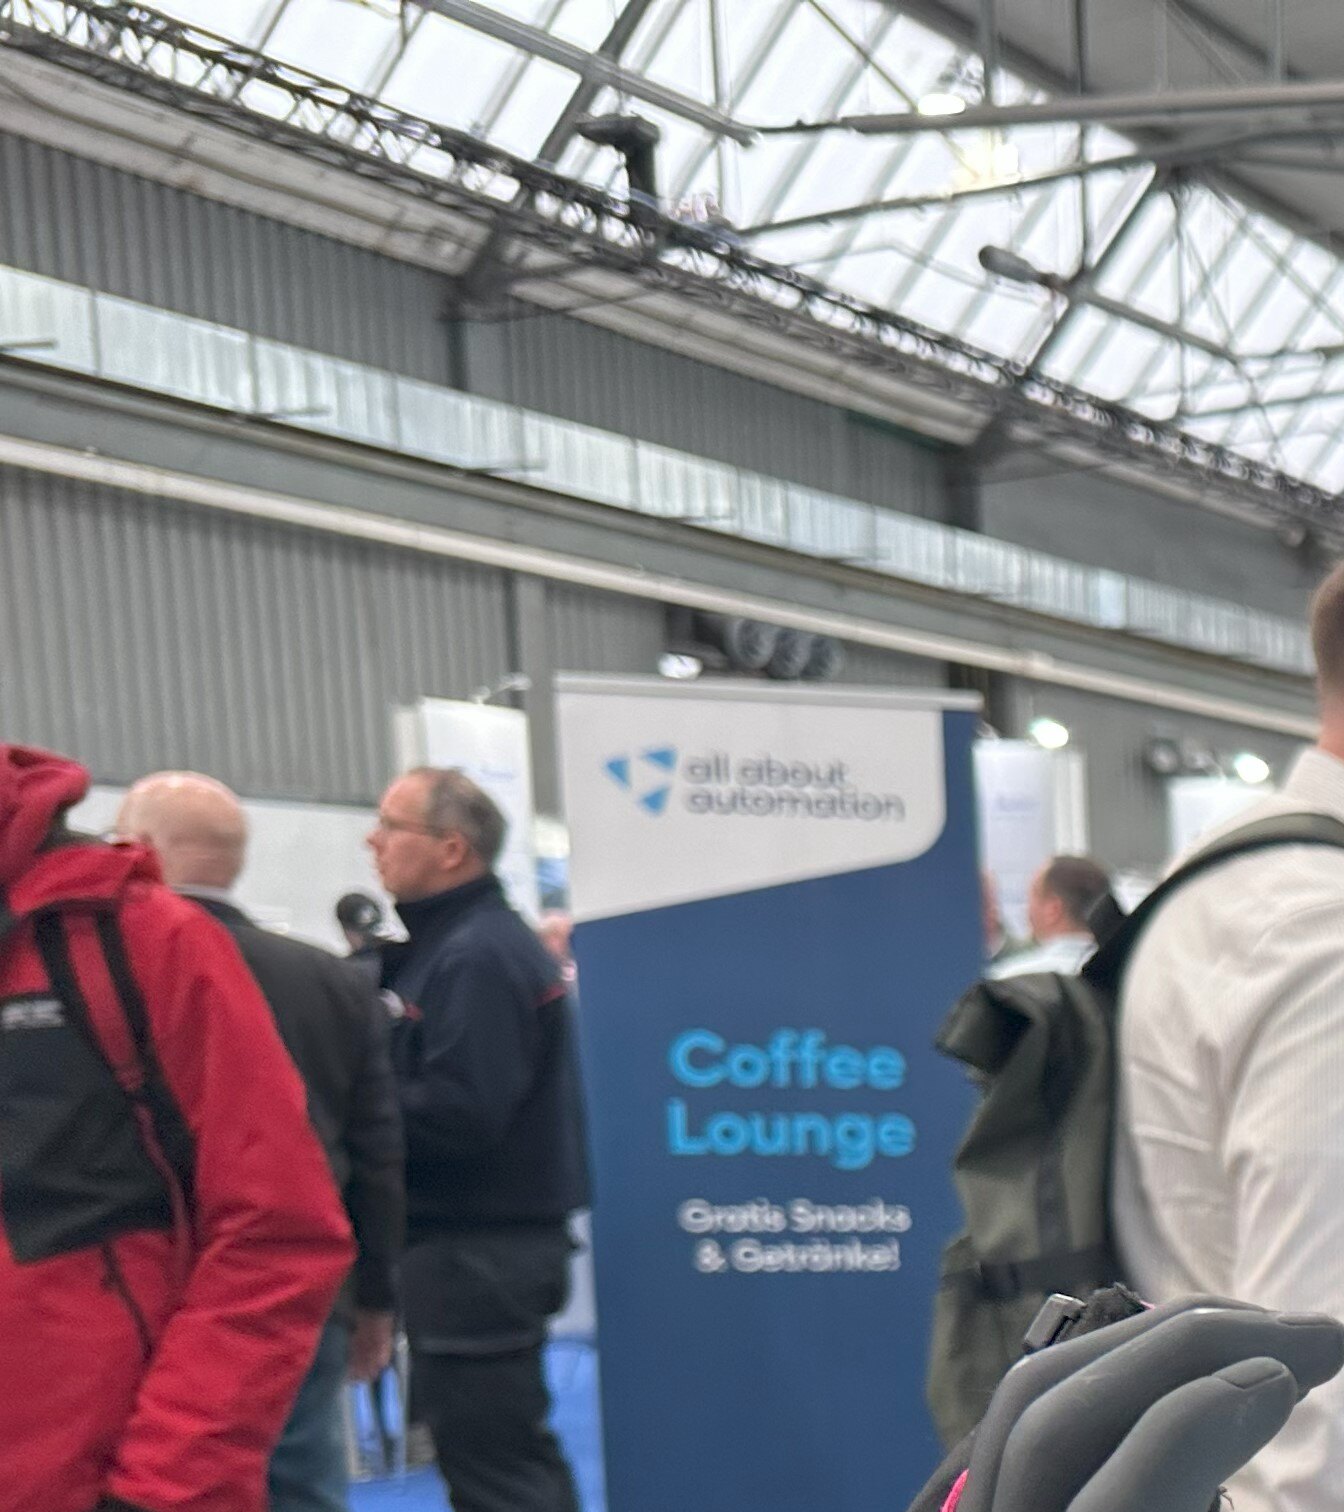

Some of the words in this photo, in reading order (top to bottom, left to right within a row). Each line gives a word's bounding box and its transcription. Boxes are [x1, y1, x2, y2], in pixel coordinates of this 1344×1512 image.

[683, 753, 731, 784] all
[739, 754, 847, 787] about
[684, 788, 906, 821] automation
[668, 1027, 907, 1089] Coffee
[667, 1097, 917, 1170] Lounge
[678, 1198, 787, 1233] Gratis
[788, 1198, 912, 1233] Snacks
[694, 1238, 727, 1273] &
